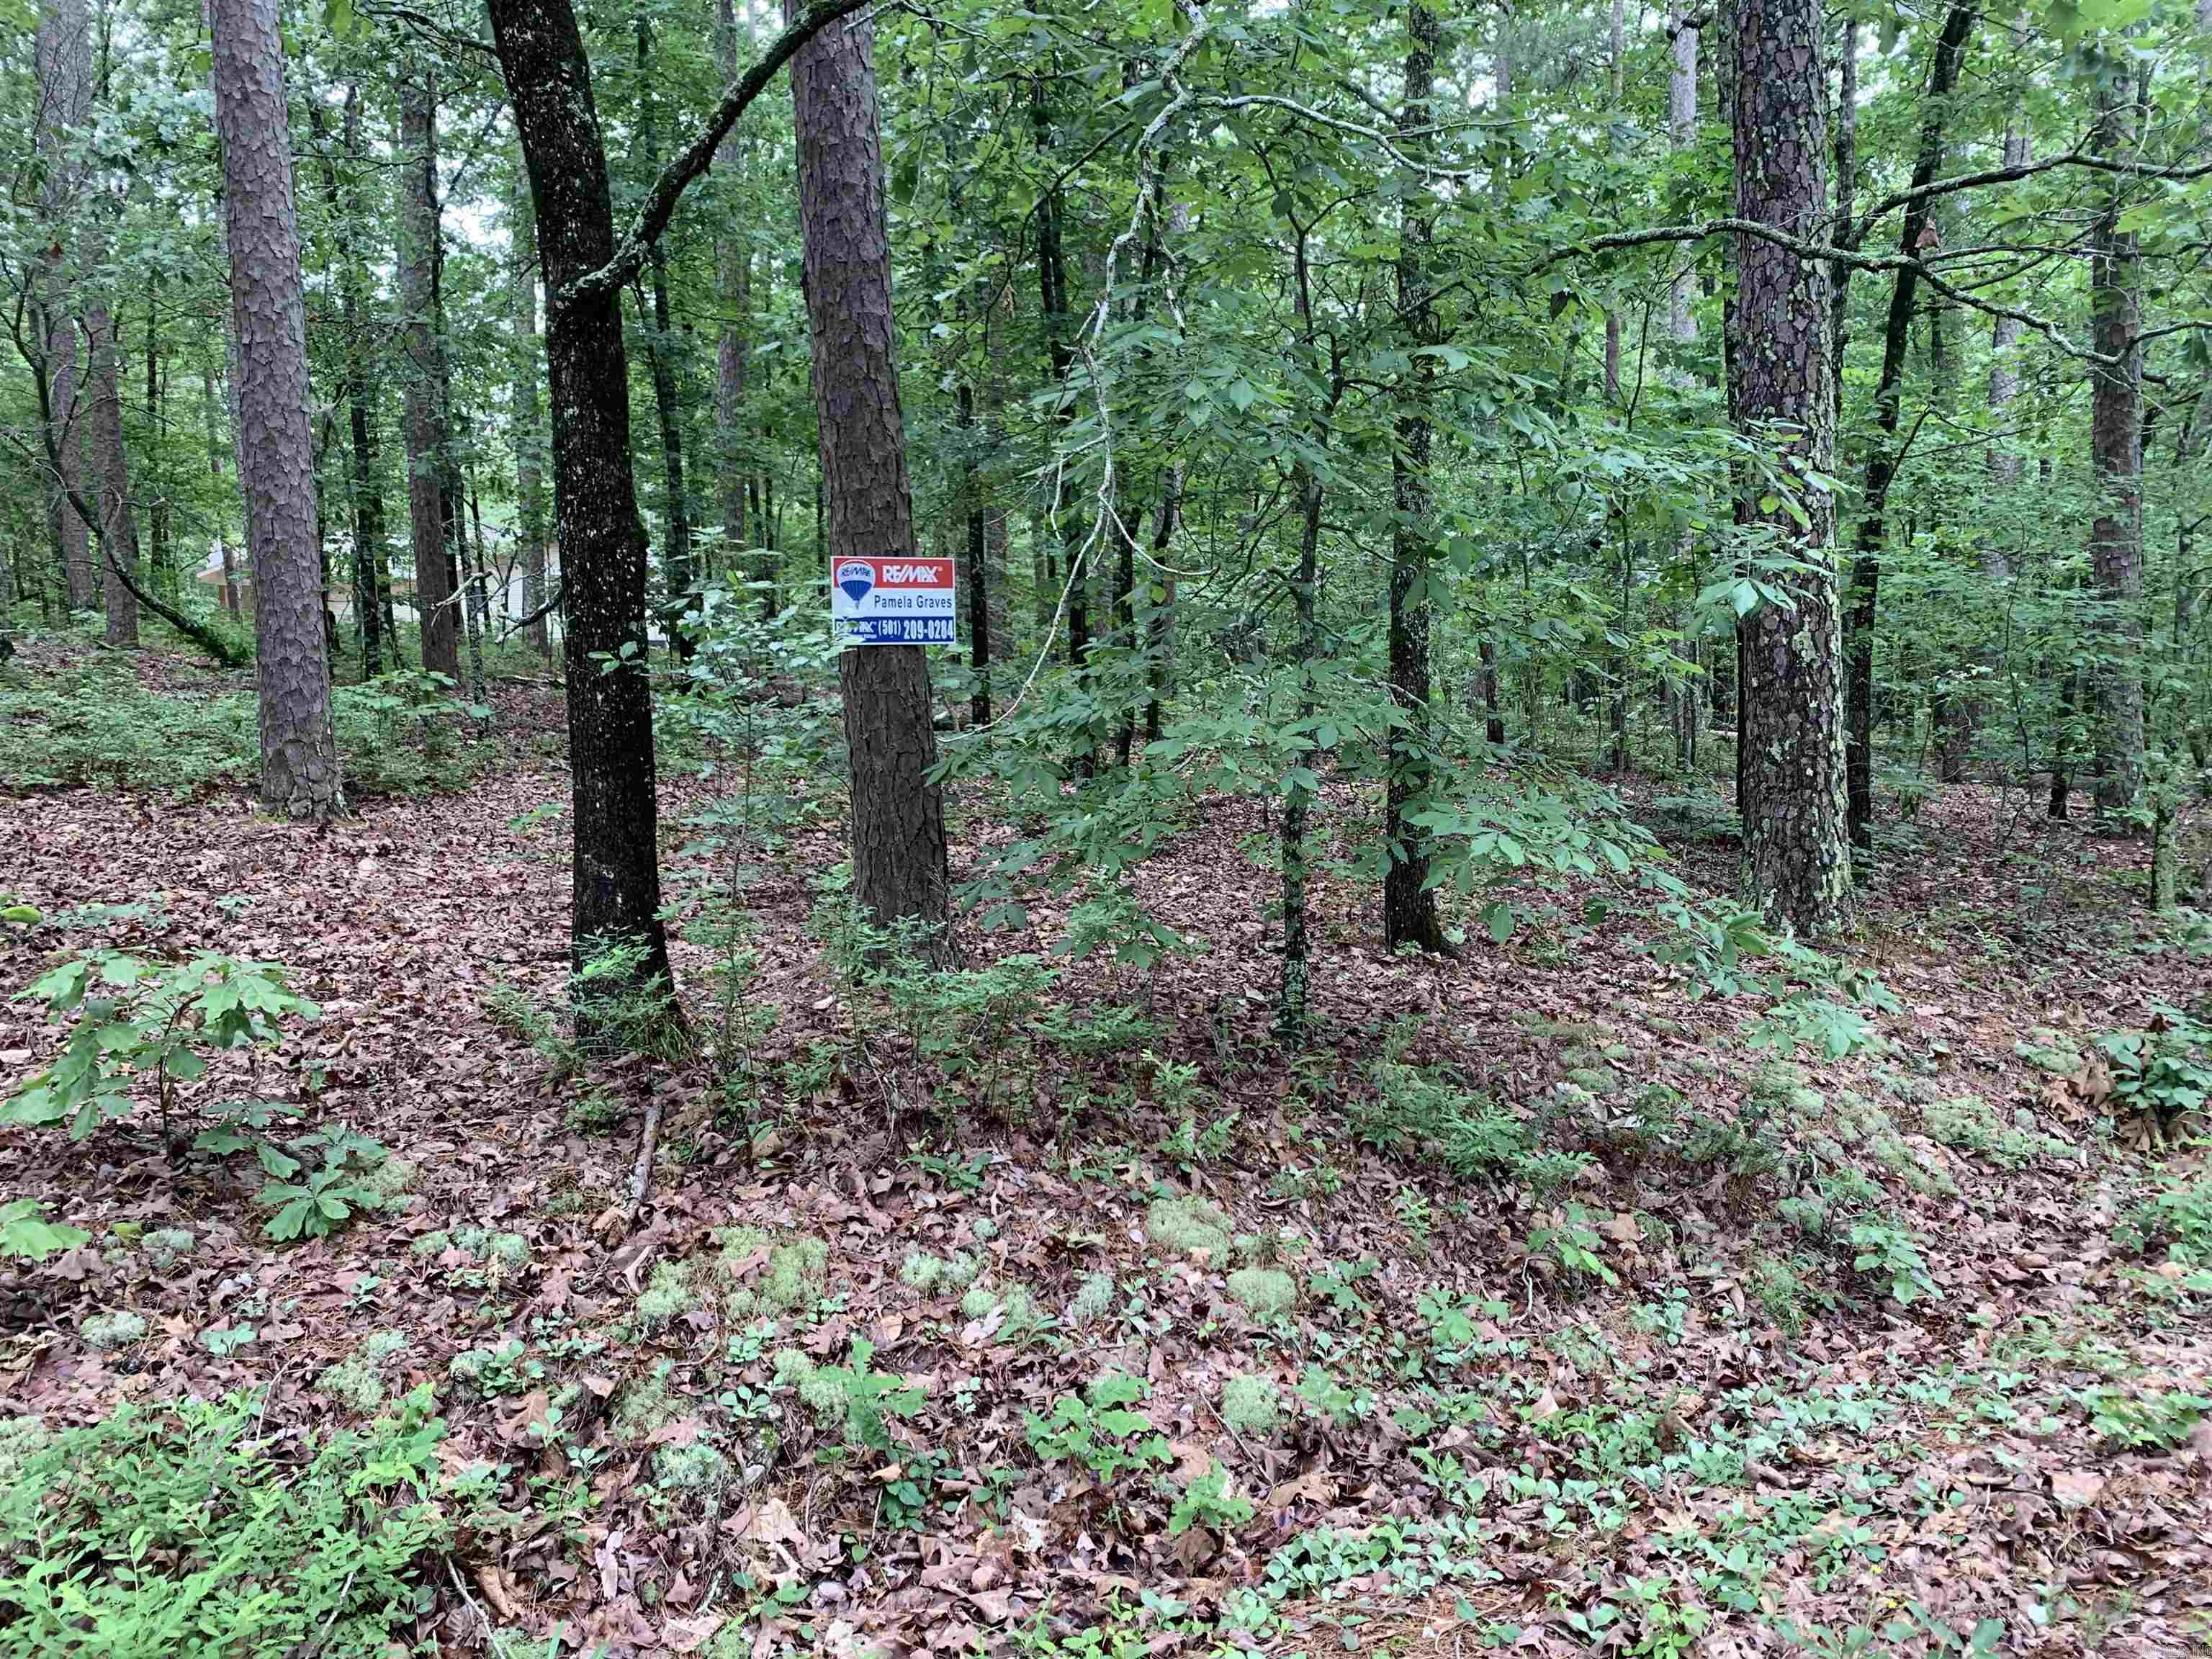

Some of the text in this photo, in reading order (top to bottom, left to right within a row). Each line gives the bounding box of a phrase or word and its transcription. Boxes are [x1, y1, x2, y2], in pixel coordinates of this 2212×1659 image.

[874, 595, 952, 608] Pamela Graves
[878, 619, 953, 640] (501) 209-0284
